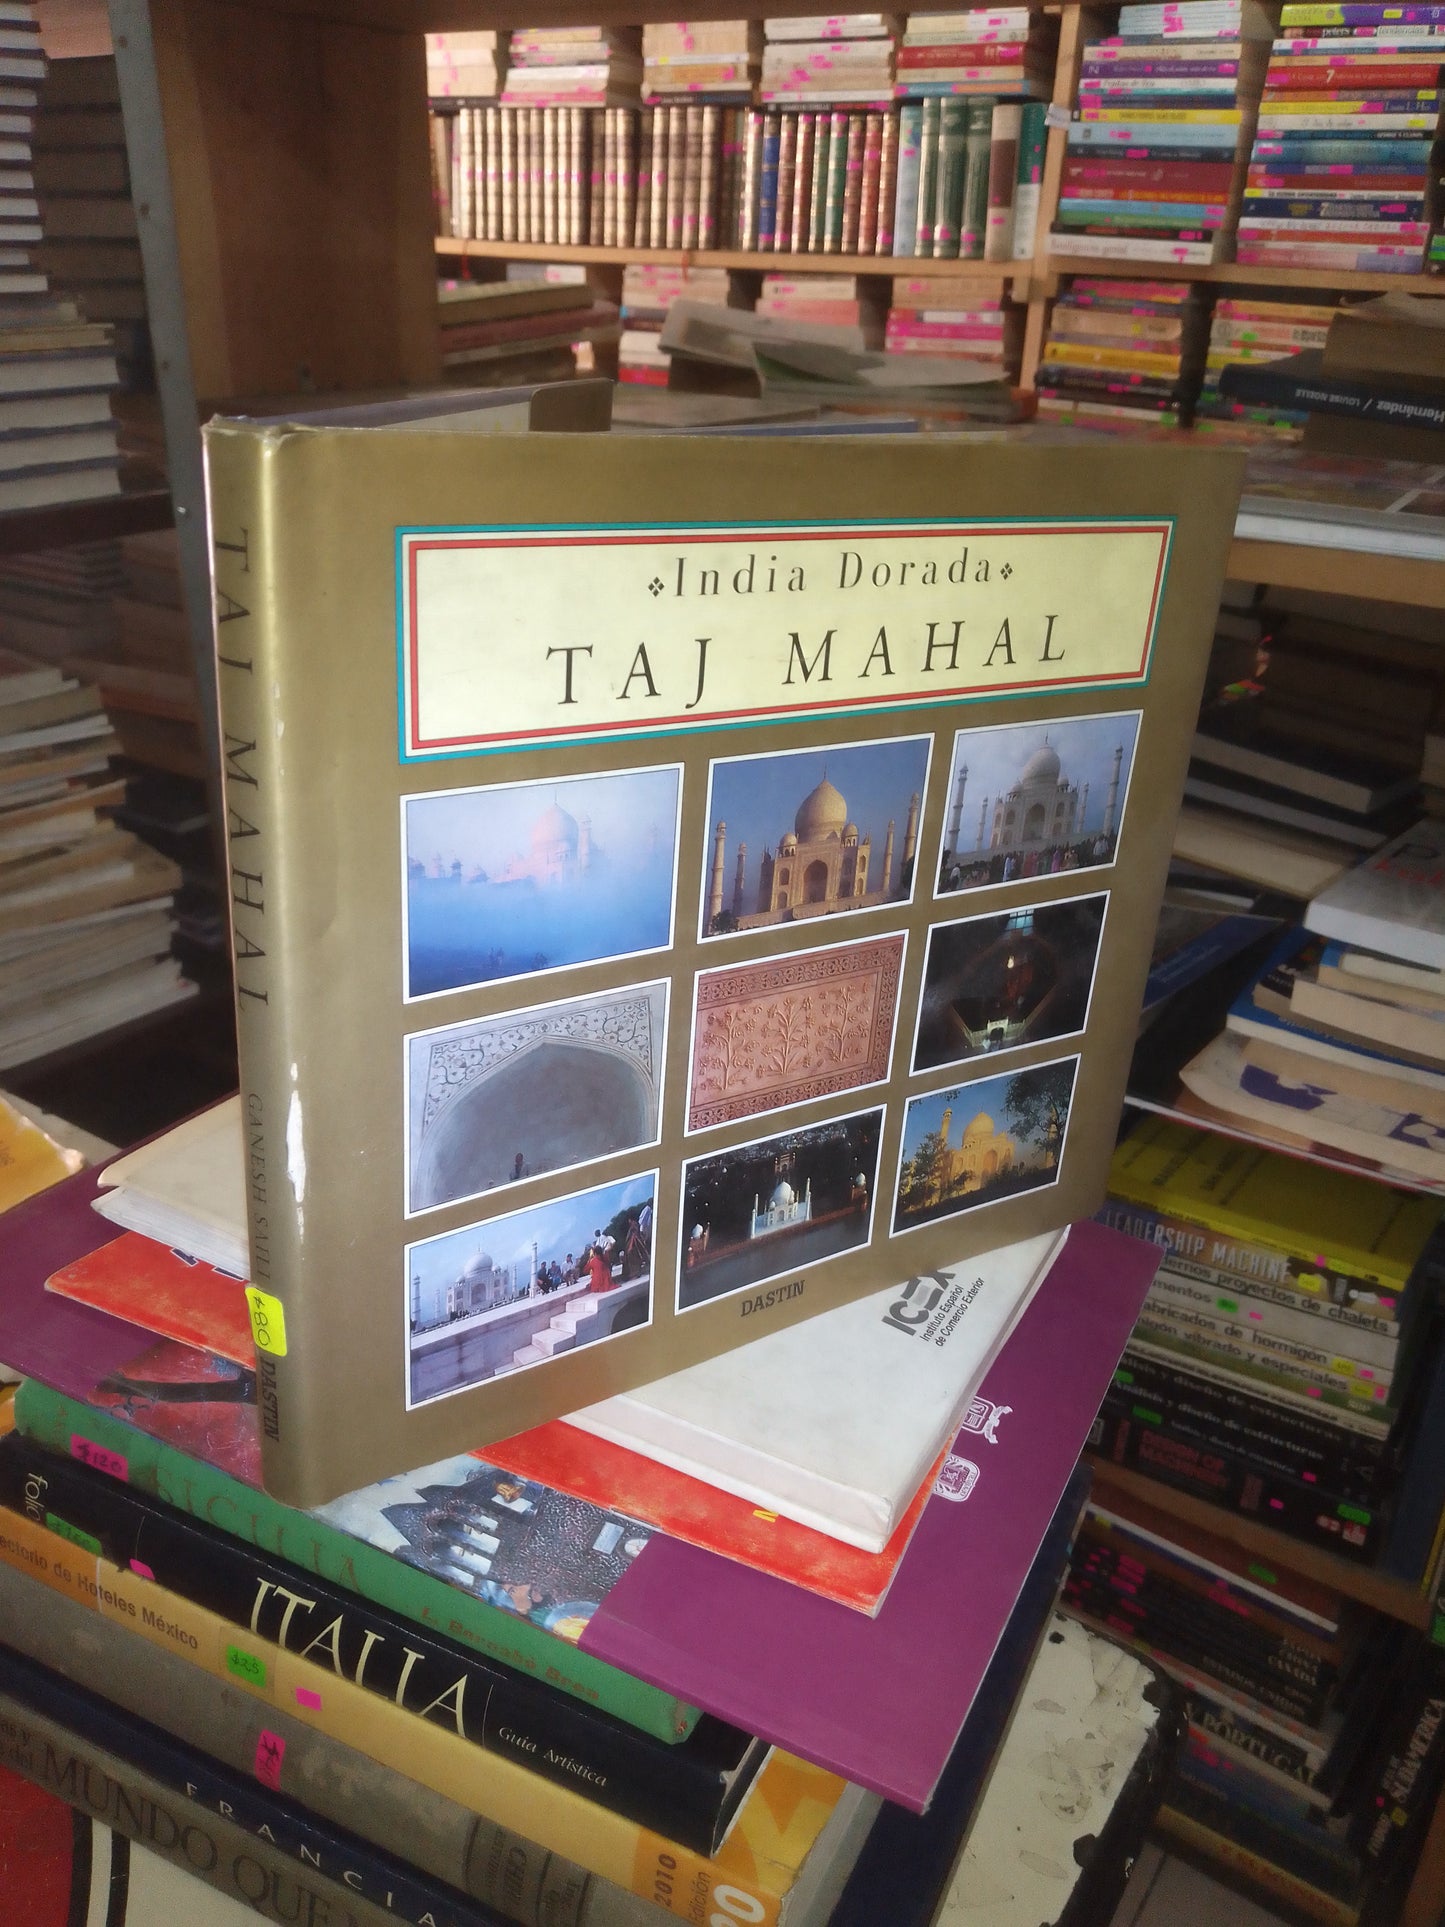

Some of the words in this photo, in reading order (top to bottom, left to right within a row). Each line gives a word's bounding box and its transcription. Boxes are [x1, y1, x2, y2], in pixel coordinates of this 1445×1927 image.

[214, 527, 253, 675] TAJ
[675, 554, 807, 598] India
[840, 547, 992, 591] Dorada
[546, 638, 712, 709] TAJ
[781, 614, 1068, 687] MAHAL
[224, 732, 270, 1013] MAHAL
[740, 1279, 805, 1317] DASTIN
[919, 1311, 945, 1342] Instituto
[939, 1284, 964, 1314] Español
[940, 1303, 968, 1337] Comercio
[961, 1277, 985, 1306] Exterior
[935, 1336, 947, 1347] de
[53, 1562, 72, 1583] de
[77, 1572, 137, 1617] Hoteles
[142, 1605, 198, 1650] México
[250, 1576, 468, 1738] ITALIA
[45, 1741, 218, 1872] MUNDO
[186, 1781, 438, 1927] FRANCIA
[654, 1853, 676, 1908] 2010
